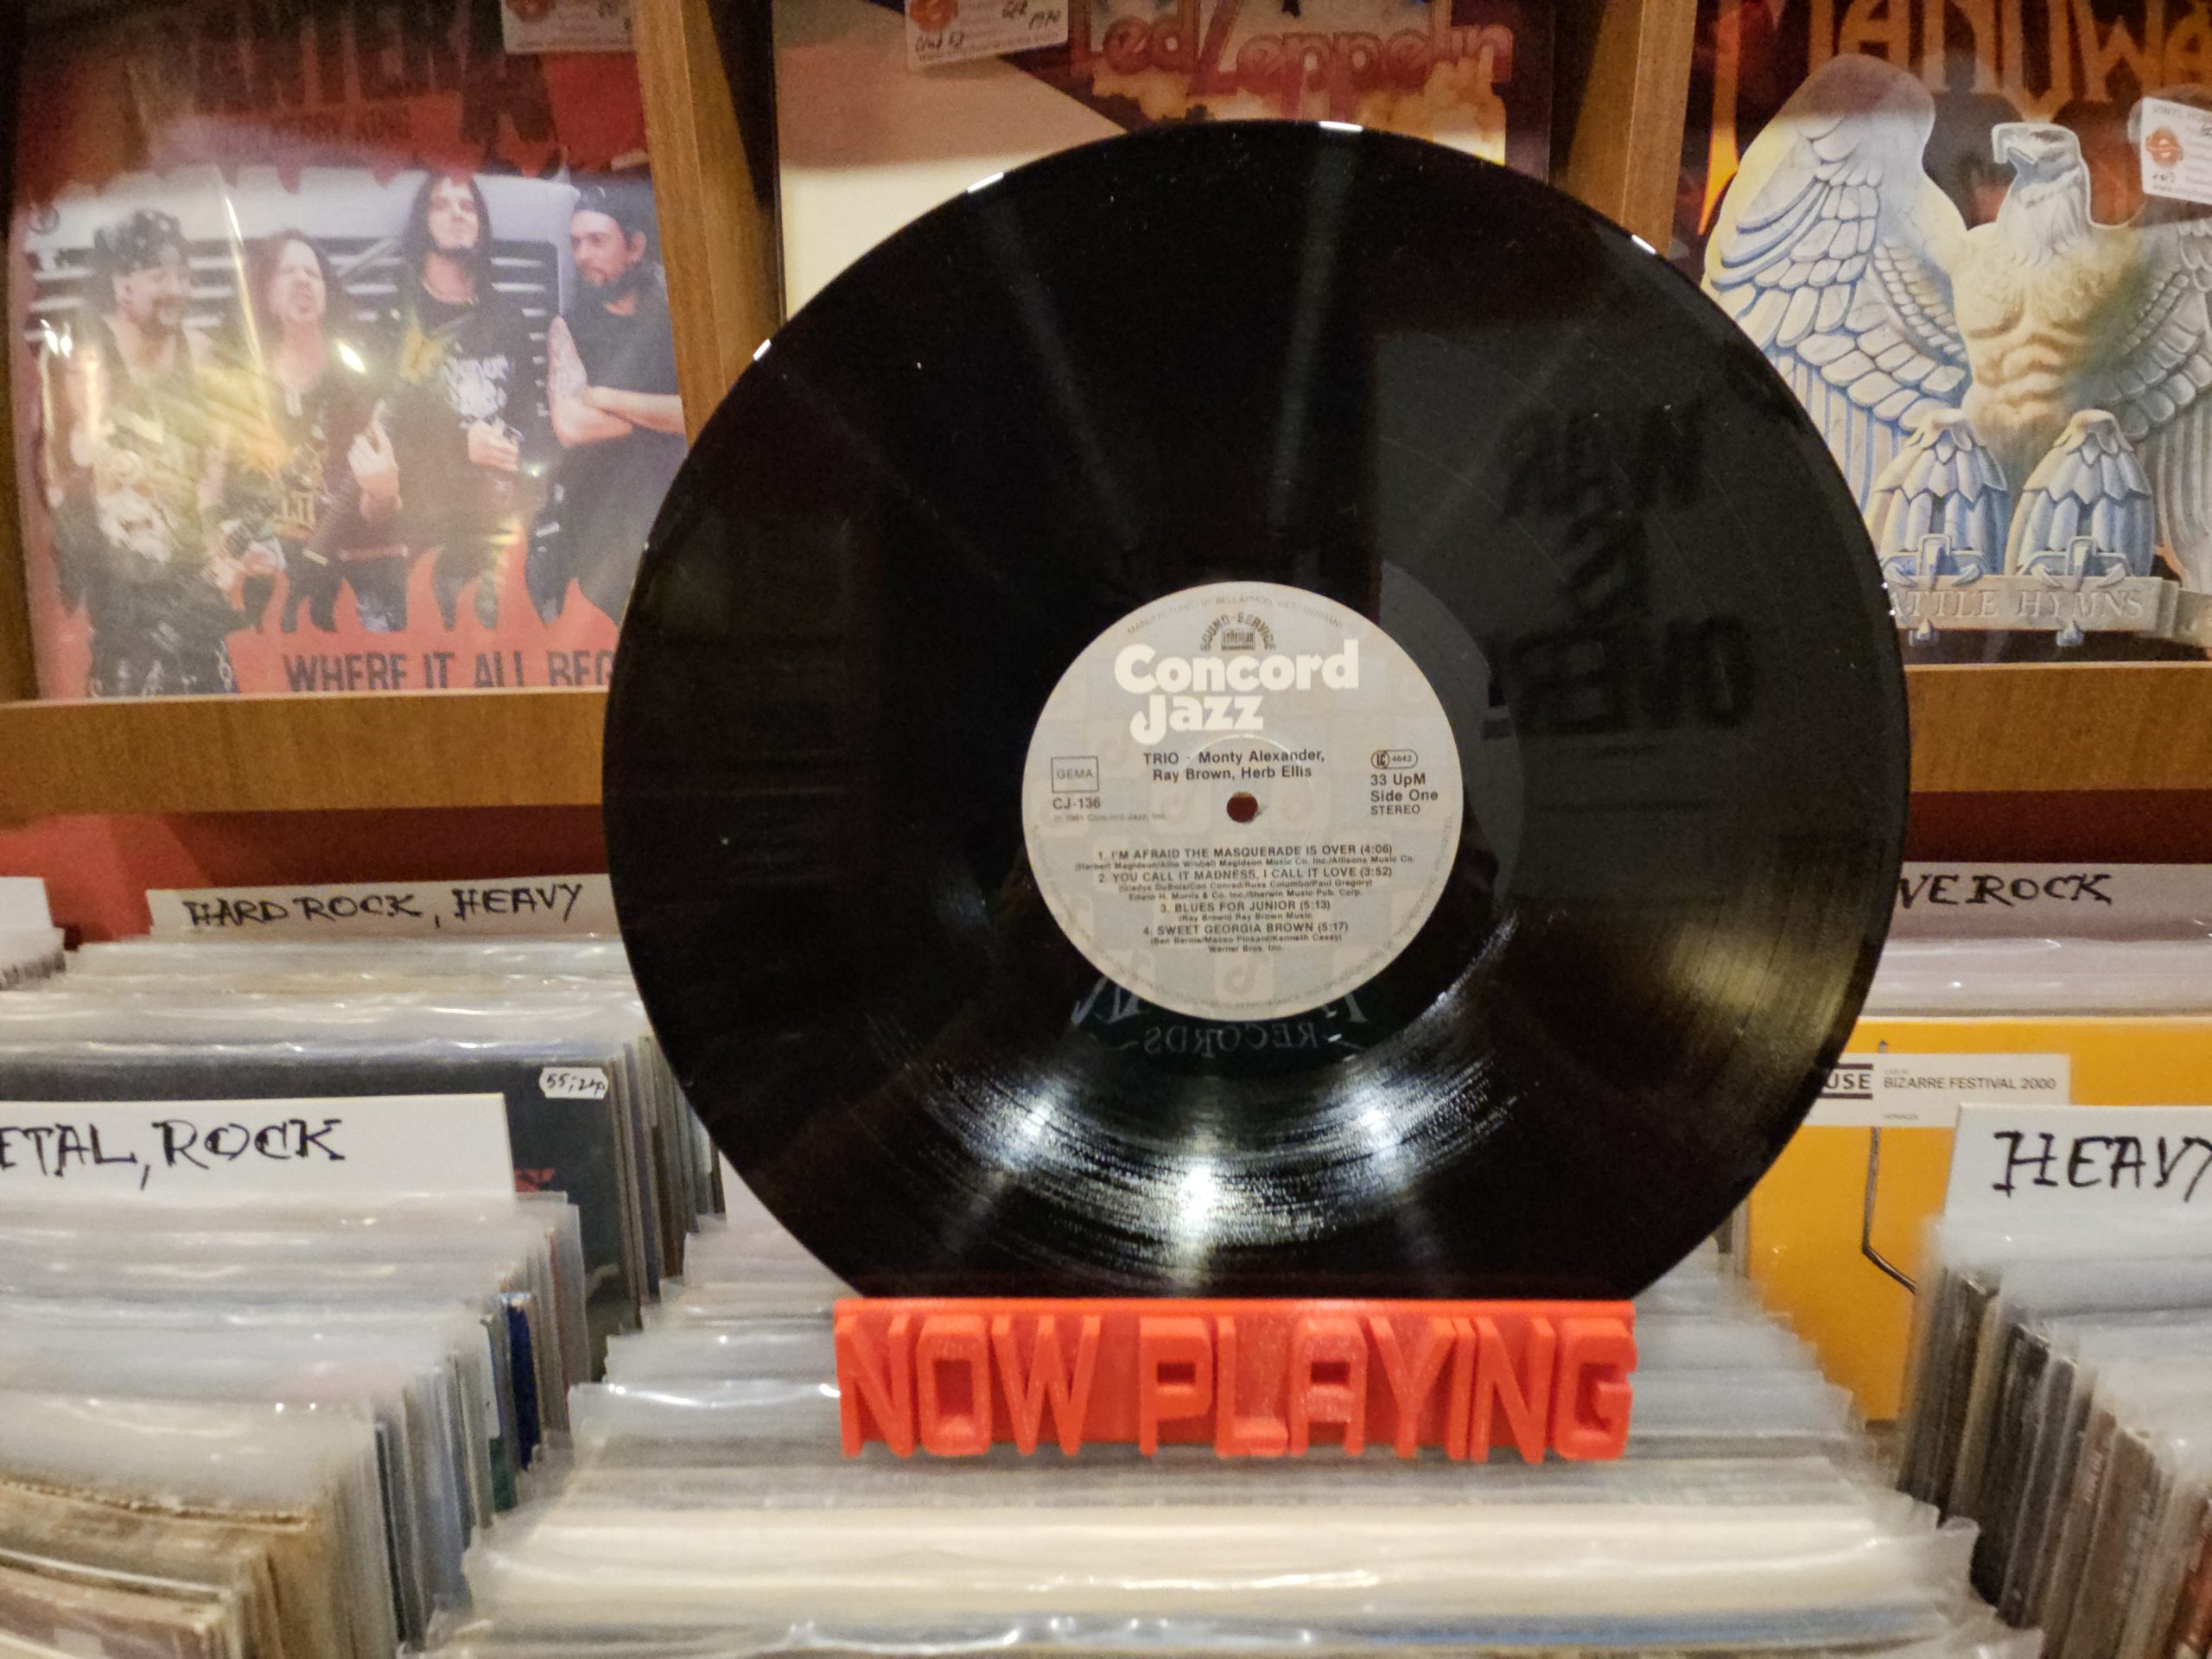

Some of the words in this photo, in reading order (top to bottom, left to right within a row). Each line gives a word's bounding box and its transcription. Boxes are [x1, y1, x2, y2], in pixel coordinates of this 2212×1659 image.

[2018, 590, 2143, 619] HYMNS
[423, 652, 455, 689] IT
[1115, 639, 1359, 694] Concord
[1130, 694, 1263, 746] Jazz
[1143, 753, 1179, 766] TRIO
[1198, 752, 1243, 765] Monty
[1249, 749, 1325, 763] Alexander,
[1056, 768, 1094, 779] GEMA
[1153, 768, 1179, 783] Ray
[1185, 767, 1236, 781] Brown,
[1241, 766, 1276, 779] Herb
[1281, 765, 1313, 778] Ellis
[1370, 774, 1387, 786] 33
[1393, 772, 1427, 788] UpM
[1052, 797, 1102, 810] CJ-136
[1370, 790, 1403, 803] Side
[1409, 789, 1439, 802] One
[1370, 804, 1421, 816] STEREO
[1111, 849, 1129, 860] I'M
[1134, 849, 1180, 860] AFRAID
[1185, 847, 1210, 858] THE
[1213, 844, 1302, 858] MASQUERADE
[1306, 844, 1318, 855] IS
[1321, 843, 1357, 855] OVER
[1360, 842, 1393, 855] (4:06)
[1370, 855, 1397, 863] Music
[1112, 872, 1138, 883] YOU
[1142, 871, 1174, 882] CALL
[1179, 870, 1190, 881] IT
[1194, 868, 1260, 881] MADNESS,
[1271, 868, 1305, 879] CALL
[1307, 867, 1319, 878] IT
[1323, 866, 1357, 877] LOVE
[1360, 866, 1393, 878] (3:52)
[1287, 889, 1313, 898] Music
[181, 896, 289, 928] HARD
[451, 883, 583, 922] HEAVY
[1174, 902, 1215, 913] BLUES
[1219, 901, 1245, 912] FOR
[1249, 899, 1296, 912] JUNIOR
[1300, 899, 1332, 912] (5:13)
[1157, 924, 1199, 936] SWEET
[1204, 922, 1262, 934] GEORGIA
[1266, 922, 1314, 933] BROWN
[1318, 921, 1349, 934] (5:17)
[1883, 1077, 1945, 1090] BIZARRE
[1948, 1077, 2017, 1090] FESTIVAL
[2020, 1077, 2057, 1090] 2000
[834, 1313, 1103, 1457] NOW
[1139, 1313, 1638, 1462] PLAYING
